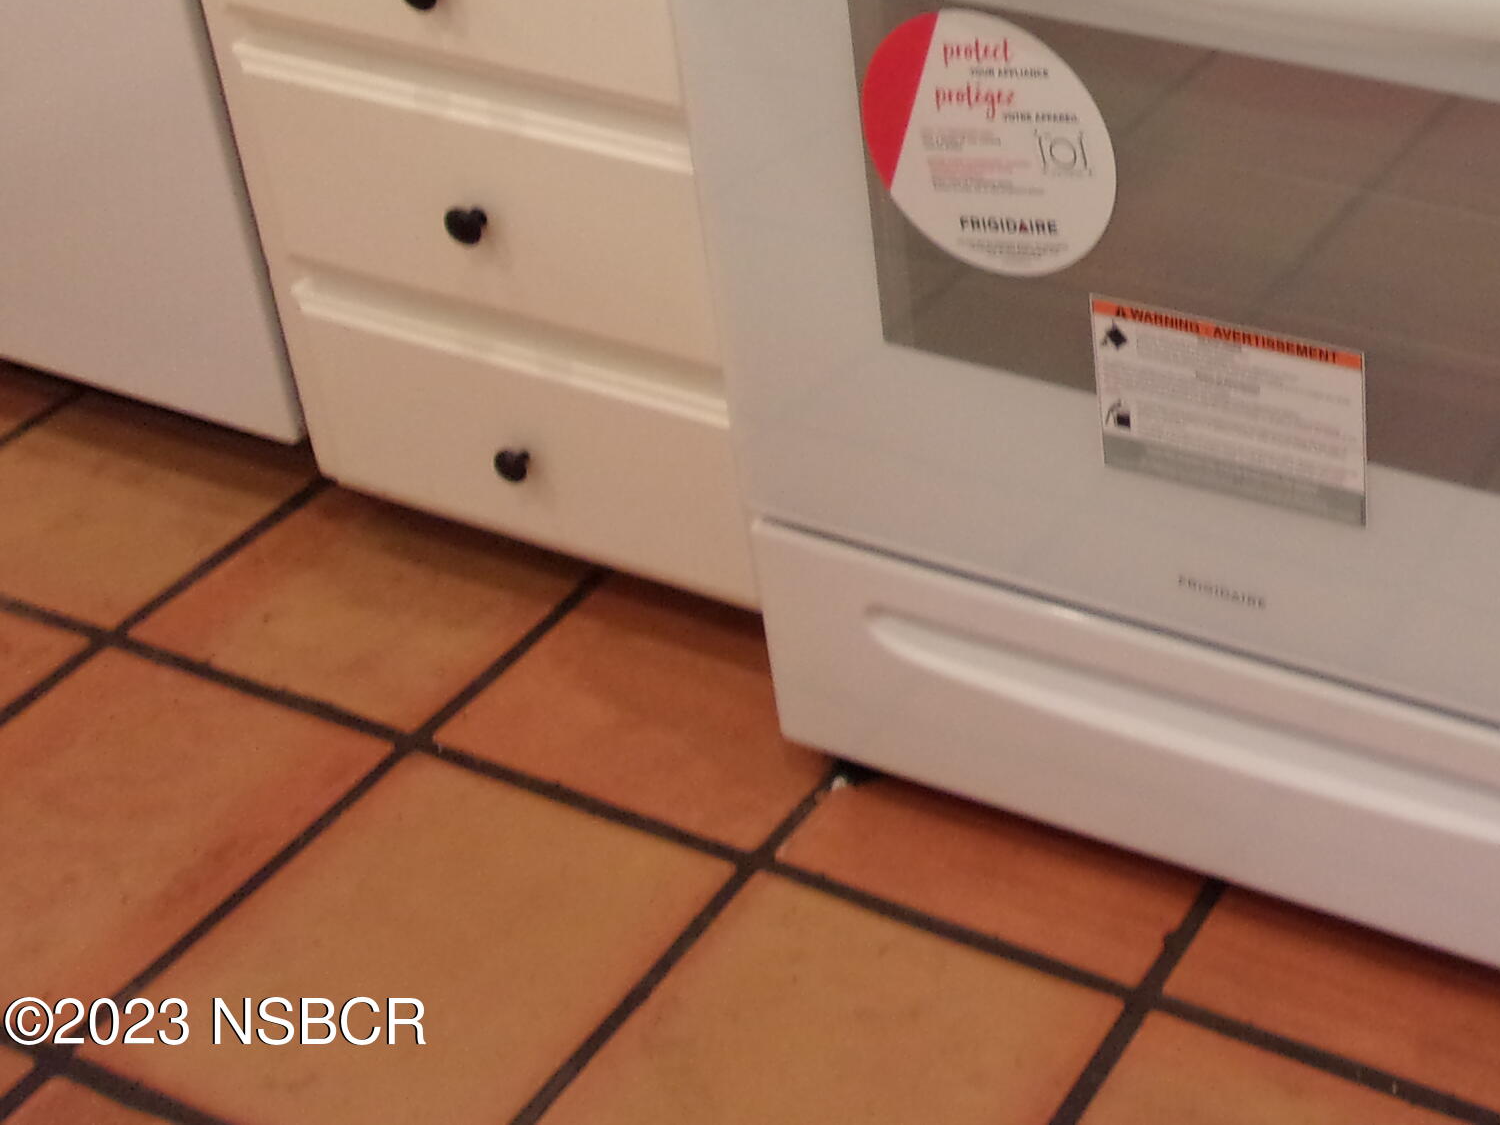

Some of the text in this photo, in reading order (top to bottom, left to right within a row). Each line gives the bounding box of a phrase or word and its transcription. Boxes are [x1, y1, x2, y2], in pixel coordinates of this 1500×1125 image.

[943, 38, 1011, 67] protect
[959, 214, 1058, 236] FRIGIDAIRE
[1131, 307, 1200, 334] WARNING
[1213, 326, 1337, 364] AVERTISSEMENT
